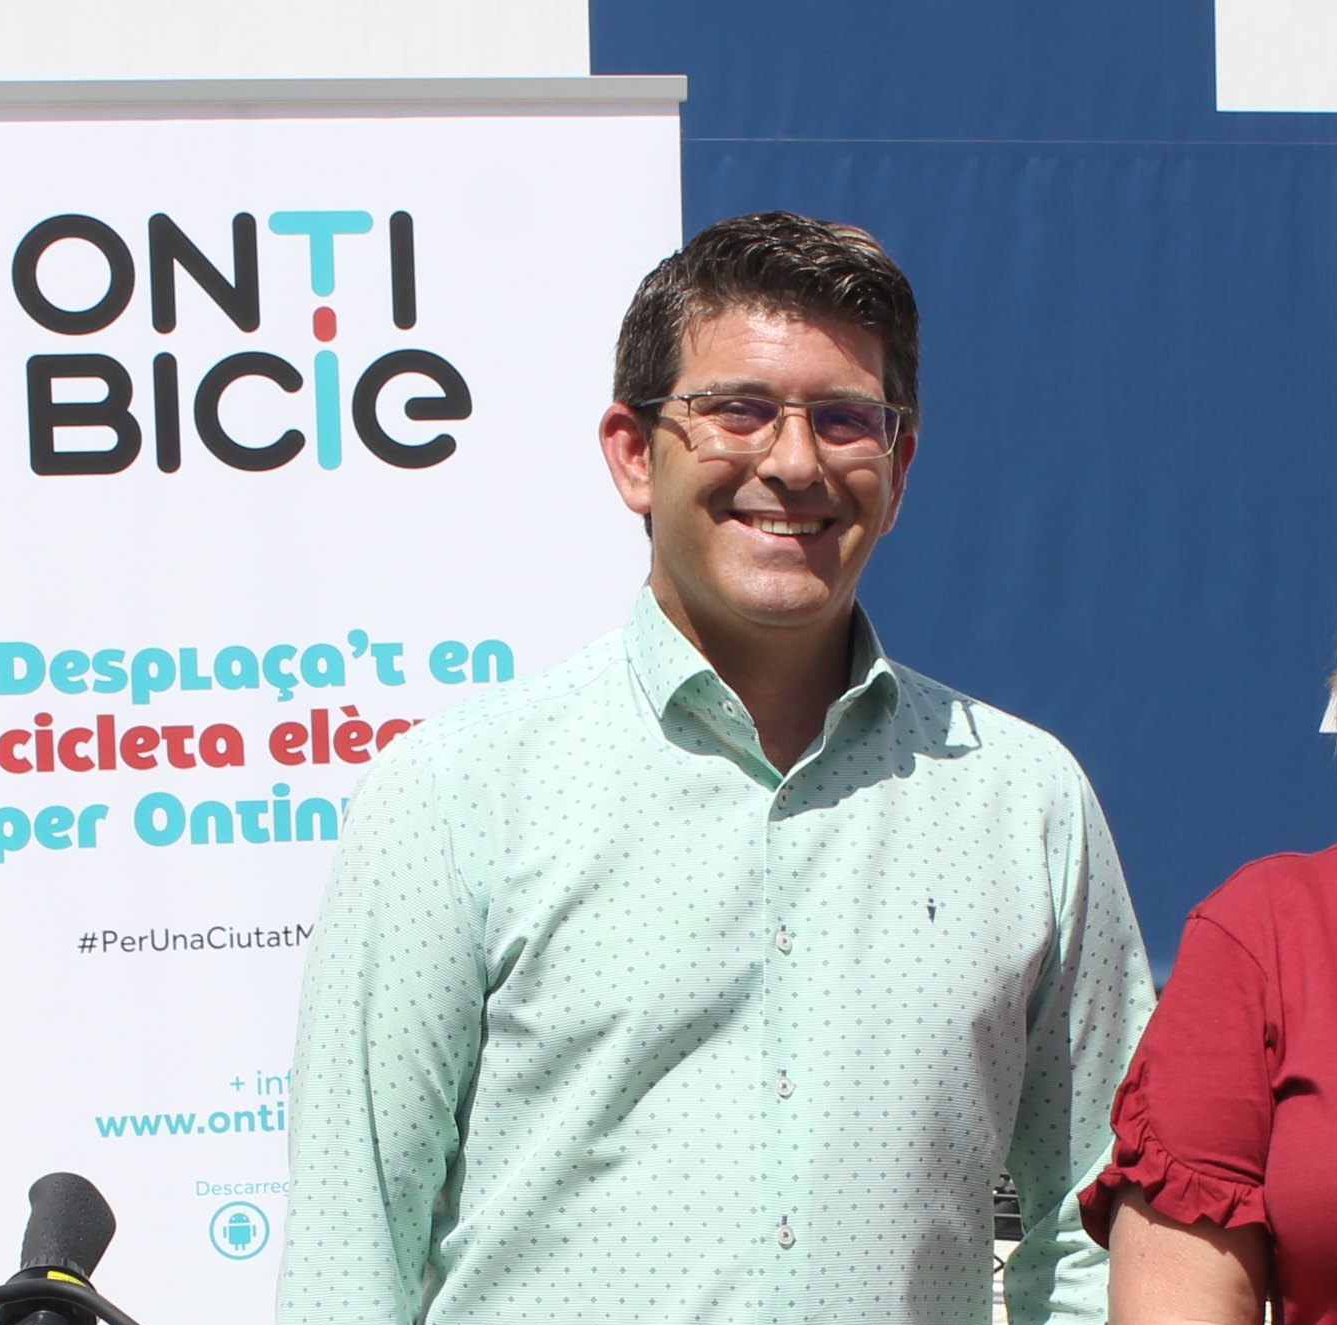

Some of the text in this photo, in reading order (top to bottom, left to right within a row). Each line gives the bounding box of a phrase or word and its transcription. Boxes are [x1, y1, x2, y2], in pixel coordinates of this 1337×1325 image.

[11, 210, 417, 338] ONTI
[426, 636, 517, 686] en
[131, 782, 350, 848] Ontin
